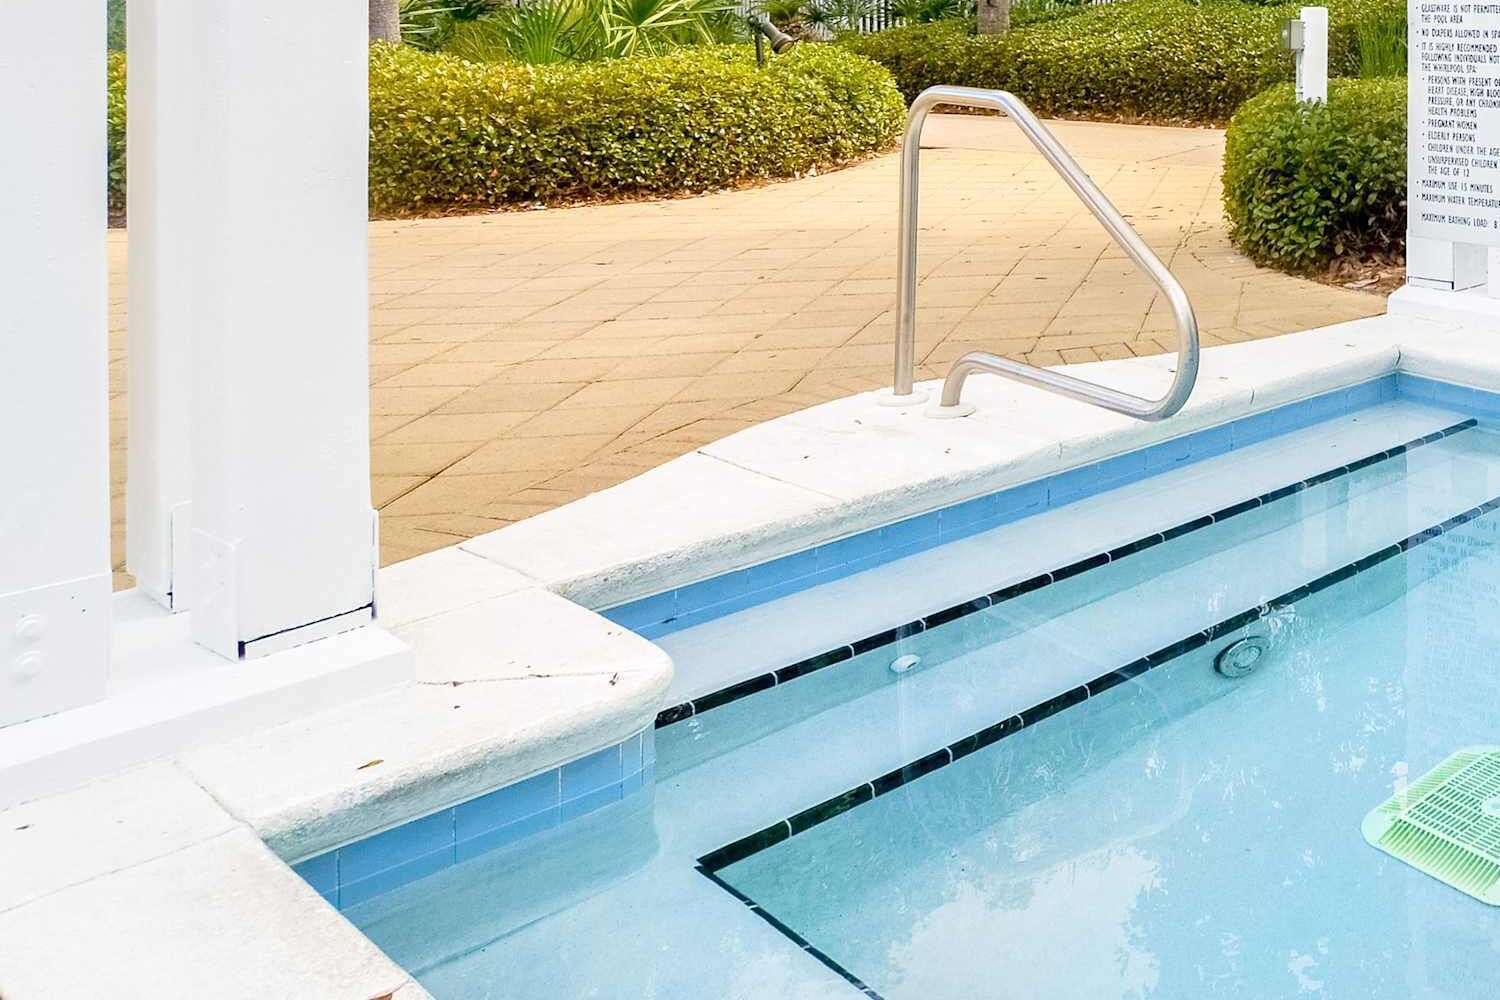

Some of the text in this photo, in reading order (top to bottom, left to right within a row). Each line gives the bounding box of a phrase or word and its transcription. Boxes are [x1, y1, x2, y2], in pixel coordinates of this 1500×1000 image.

[1454, 4, 1458, 13] IS
[1461, 4, 1470, 13] NOT
[1422, 15, 1463, 23] THE POOL AREA
[1422, 28, 1500, 38] NO DIAPERS ALLOWED IN SPA
[1436, 43, 1454, 51] HIGHLY
[1457, 43, 1497, 53] RECOMMENDED
[1422, 53, 1452, 62] FOLLOWING
[1455, 54, 1486, 63] INDIVIDUALS
[1490, 55, 1499, 64] NOT
[1422, 63, 1431, 71] THE
[1433, 64, 1464, 73] WHIRLPOOL
[1428, 76, 1450, 84] PERSONS
[1452, 76, 1465, 85] WITH
[1469, 77, 1491, 86] PRESENT
[1466, 99, 1475, 107] ANY
[1428, 107, 1477, 118] HEALTH PROBLEMS
[1428, 119, 1477, 130] PREGNANT WOMEN
[1428, 131, 1475, 142] ELDERLY PERSONS
[1428, 143, 1453, 152] CHILDREN
[1456, 145, 1473, 154] UNDER
[1477, 147, 1486, 155] THE
[1490, 148, 1499, 156] AGE
[1472, 159, 1497, 168] CHILDREN
[1429, 166, 1437, 174] THE
[1440, 167, 1450, 175] AGE
[1422, 180, 1492, 193] MAXIMUM USE 15 MINUTES
[1422, 193, 1445, 203] MAXIMUM
[1447, 195, 1464, 204] WATER
[1422, 214, 1445, 223] MAXIMUM
[1448, 216, 1470, 226] BATHING
